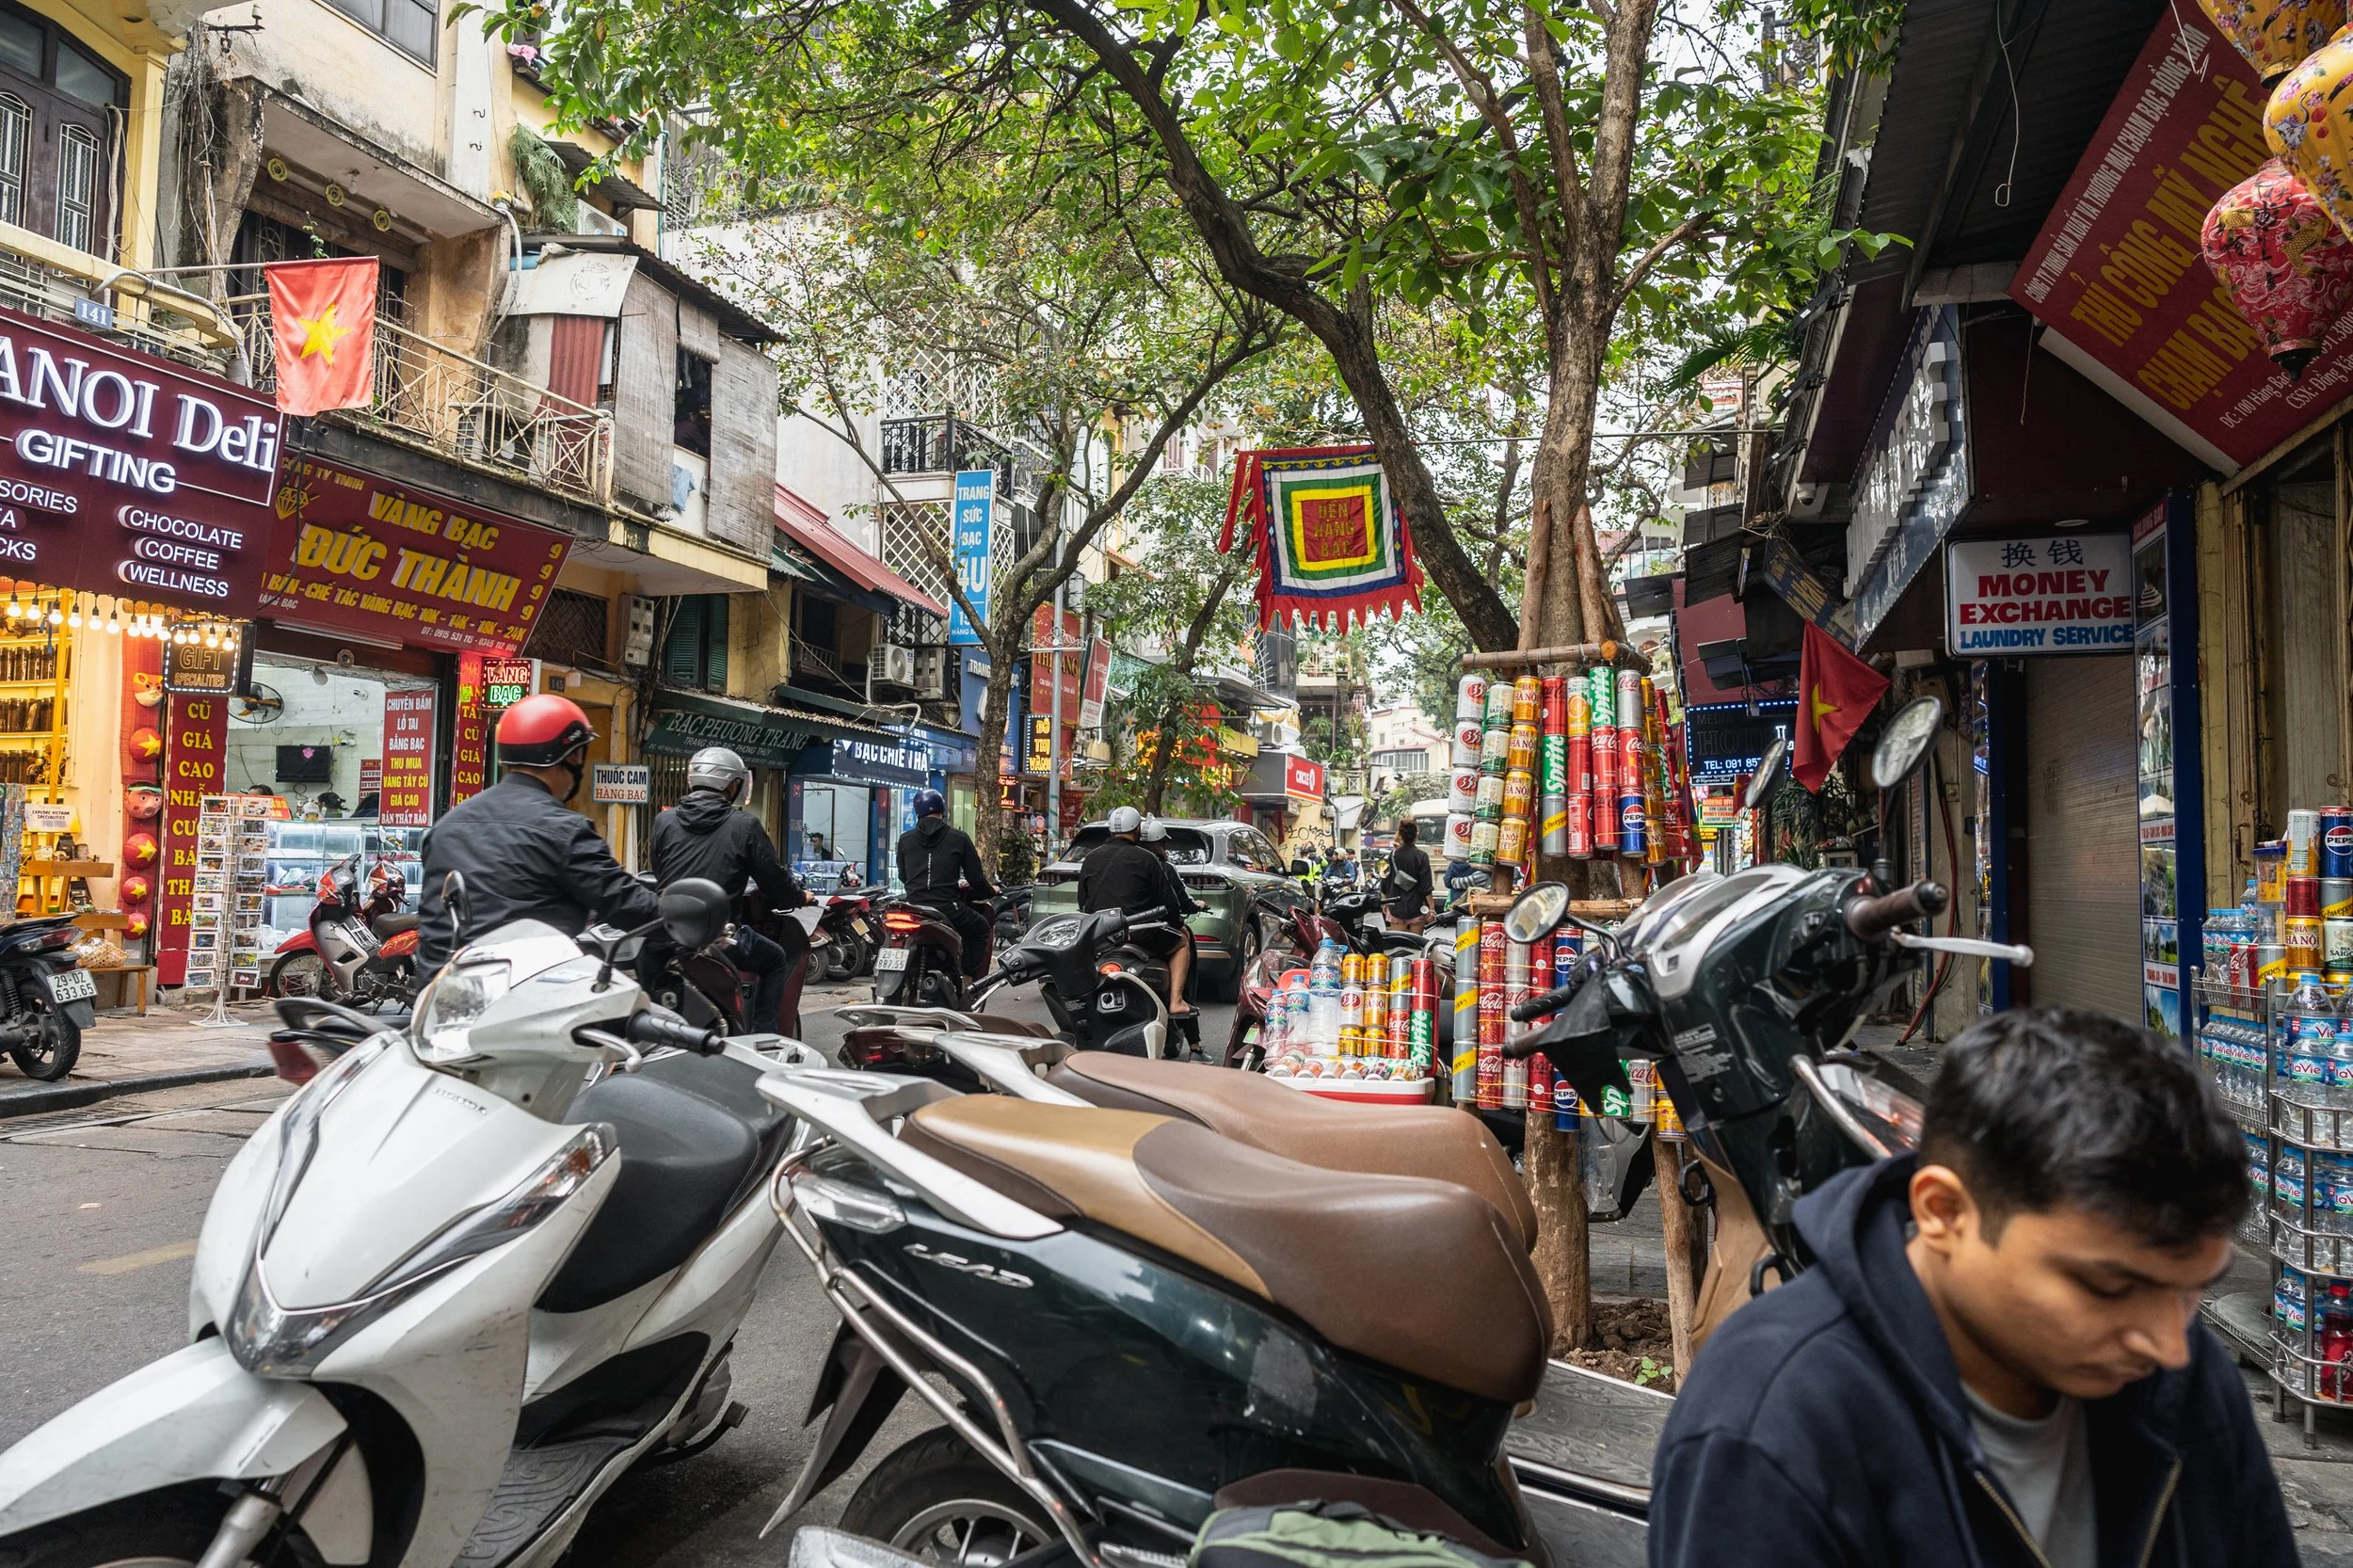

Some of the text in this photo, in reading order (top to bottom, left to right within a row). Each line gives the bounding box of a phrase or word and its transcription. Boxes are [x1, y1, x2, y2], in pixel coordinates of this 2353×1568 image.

[2024, 23, 2211, 304] CÔNG TY TNHH SẢN XUẤT VÀ THƯƠNG MẠI CHẠM BẠC ĐỒNG XÂM
[2099, 219, 2196, 310] CÔNG
[80, 304, 107, 327] 141
[2071, 271, 2143, 347] THỦ
[2137, 328, 2234, 412] CHẠM
[2286, 367, 2349, 410] CSSX: Đồng
[2219, 411, 2242, 429] ĐC:
[2234, 397, 2253, 418] 100
[2249, 384, 2282, 407] Hàng
[173, 393, 277, 472] Deli
[17, 428, 177, 493] GIFTING
[315, 466, 365, 490] TY TNHH
[957, 486, 989, 501] TRANG
[368, 489, 500, 551] VÀNG BẠC
[963, 505, 983, 522] SỨC
[130, 509, 243, 550] CHOCOLATE
[962, 532, 982, 551] BẠC
[145, 540, 219, 570] COFFEE
[2001, 540, 2083, 569] 换钱
[290, 522, 522, 613] ĐỨC THÀNH
[130, 563, 229, 598] WELLNESS
[1978, 569, 2109, 598] MONEY
[334, 587, 527, 642] TÁC VÀNG BẠC 10K 14K 18K 24K
[1961, 596, 2132, 625] EXCHANGE
[952, 628, 969, 636] HÀNG
[1961, 624, 2135, 649] LAUNDRY SERVICE
[180, 646, 225, 671] GIFT
[968, 659, 991, 678] TRANG
[174, 673, 226, 688] SPECIALITIES
[387, 694, 432, 712] CHUYÊN BẤM
[489, 685, 521, 706] BẠC
[1592, 667, 1612, 726] Sprite
[187, 699, 212, 721] CŨ
[397, 713, 418, 730] LỖ TAI
[182, 729, 214, 750] GIÁ
[390, 733, 424, 754] BẰNG BẠC
[465, 726, 479, 741] CŨ
[760, 728, 809, 751] TRANG
[391, 758, 422, 770] THU MUA
[460, 747, 480, 763] GIÁ
[1545, 736, 1566, 793] Sprite
[1704, 760, 1722, 771] TEL:
[1725, 760, 1741, 769] 091
[178, 761, 215, 779] CAO
[383, 773, 428, 788] VÀNG TÂY CŨ
[457, 771, 480, 784] CAO
[596, 765, 648, 785] THUỐC CAM
[1296, 770, 1310, 787] CIRCLE
[391, 792, 419, 807] GIÁ CAO
[595, 785, 625, 800] HÀNG
[381, 811, 394, 824] BÁN
[395, 809, 412, 824] THẤT
[174, 849, 196, 866] BÁ
[876, 958, 905, 971] 887.55
[881, 948, 905, 960] 29-C1
[54, 971, 86, 988] 29-D2
[55, 984, 94, 1001] 633.65
[2292, 1064, 2321, 1075] laVie
[903, 1243, 1034, 1289] LEAD
